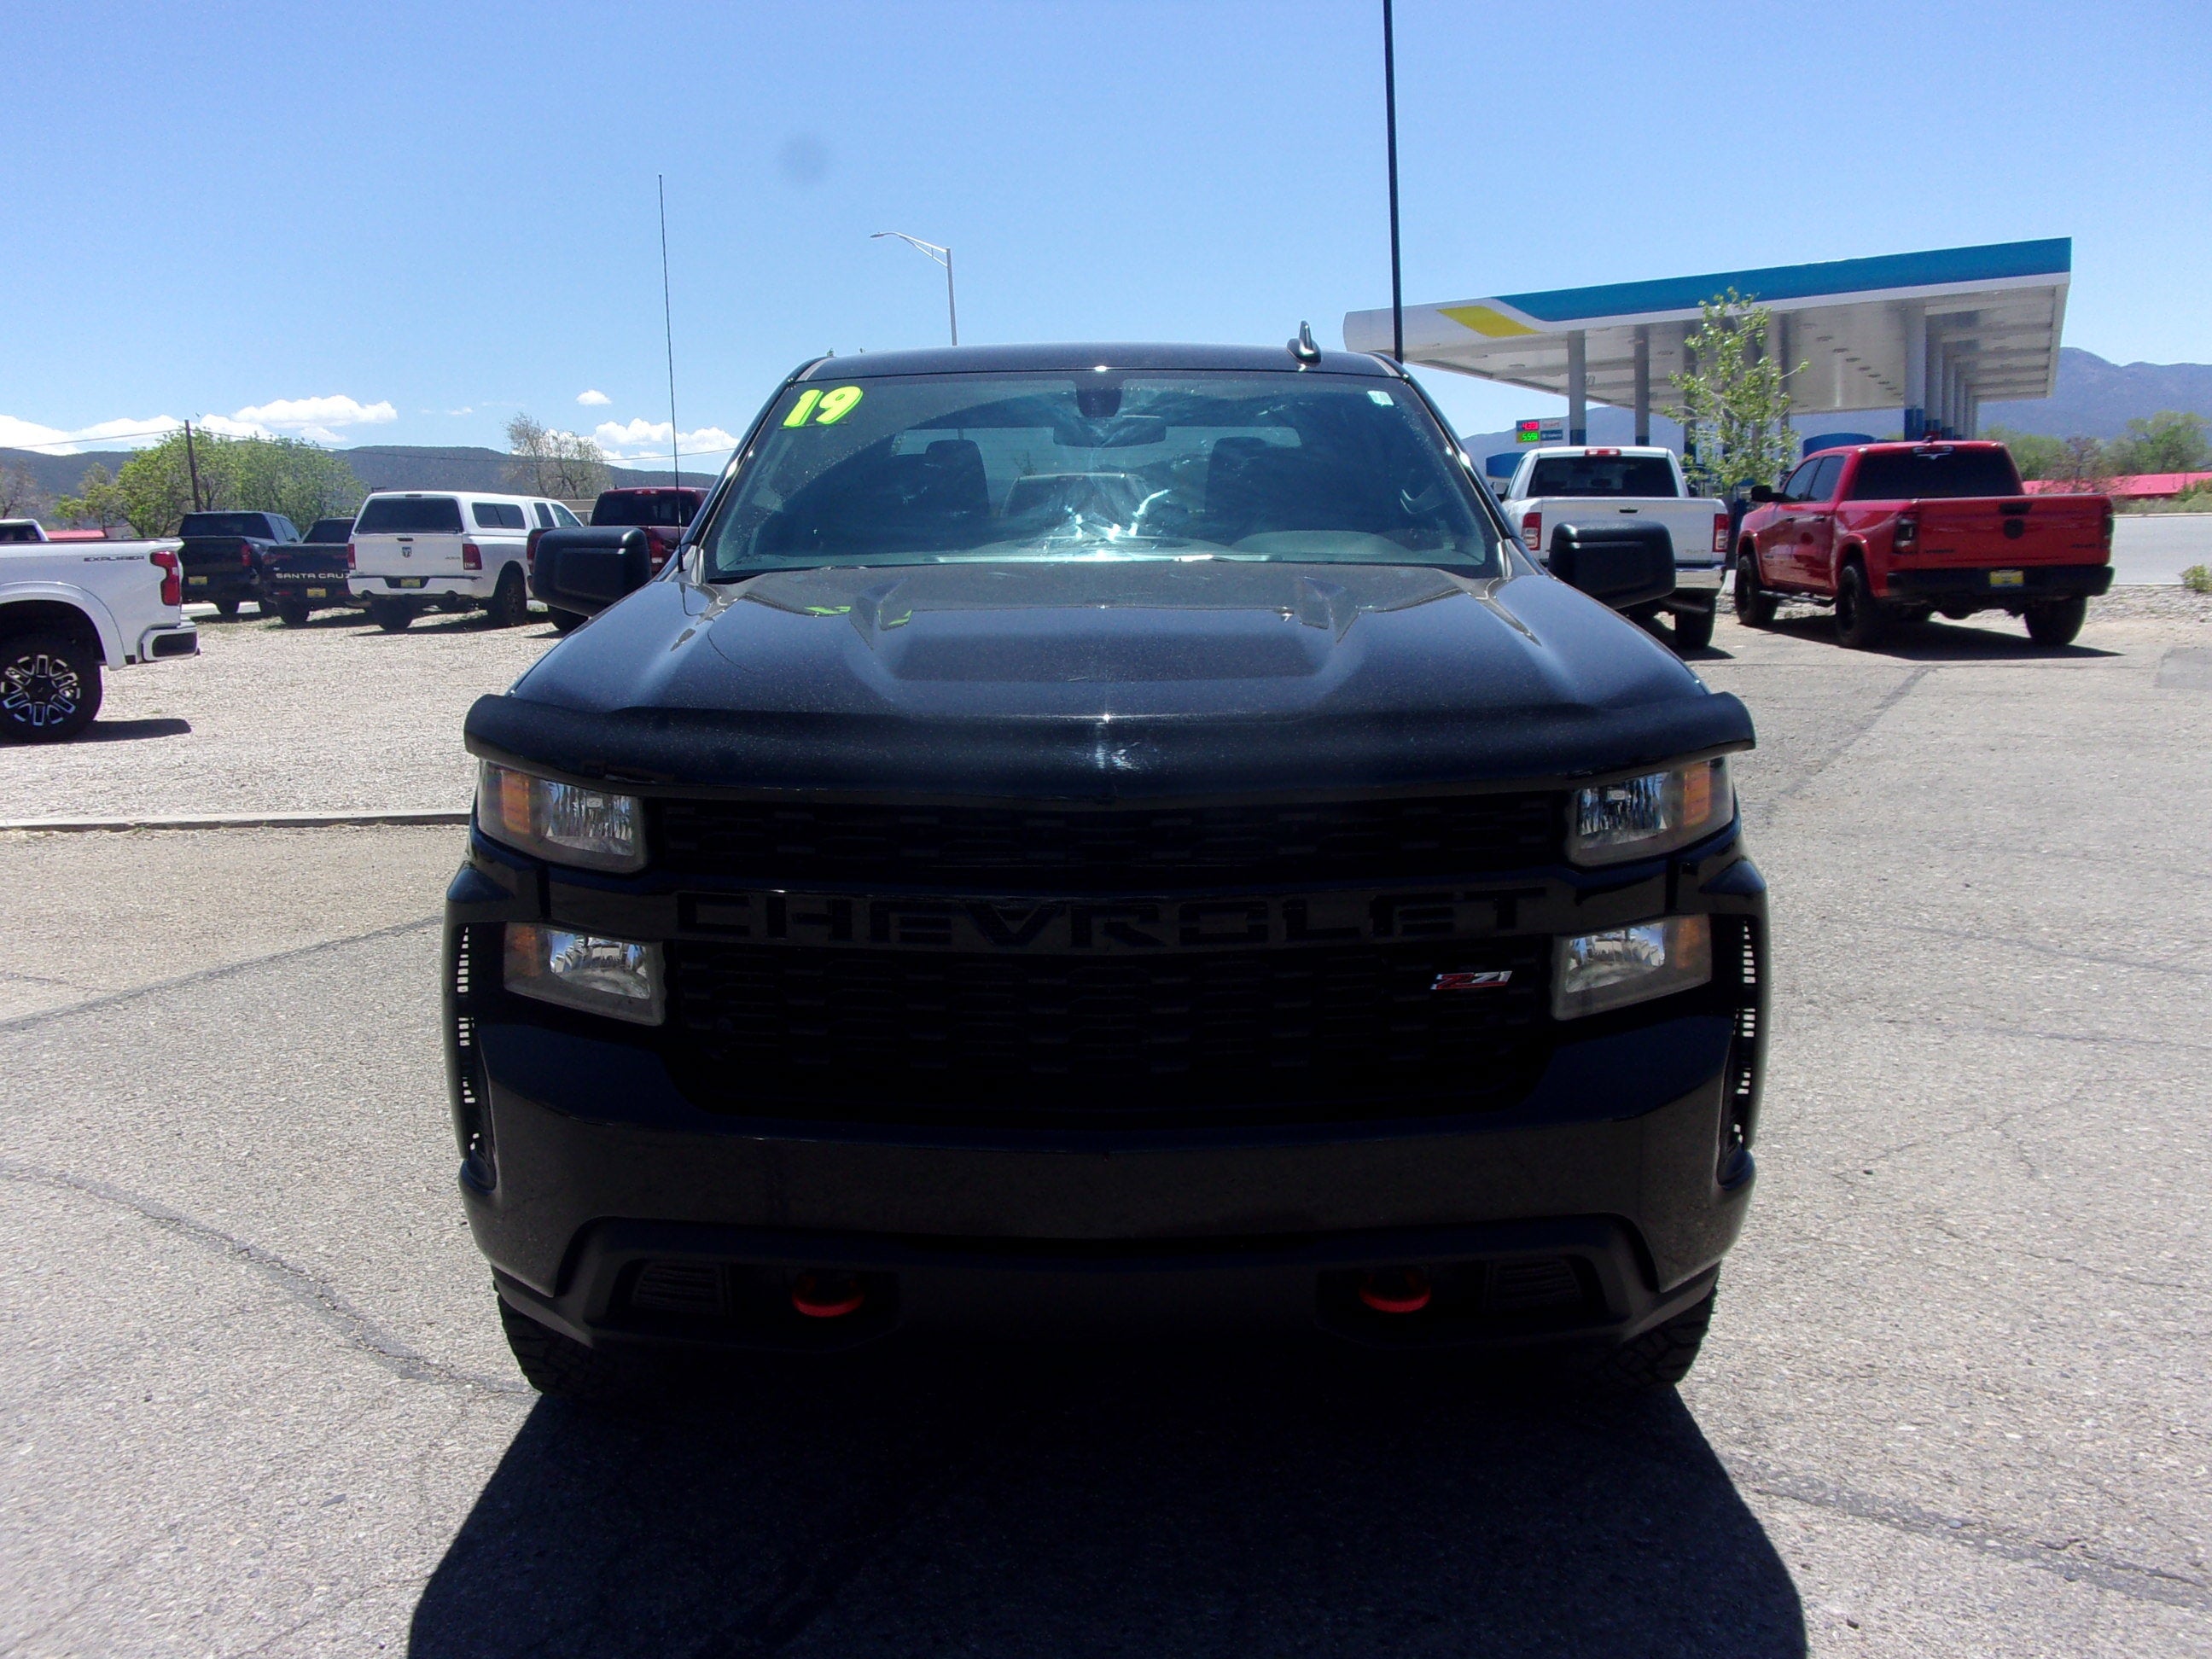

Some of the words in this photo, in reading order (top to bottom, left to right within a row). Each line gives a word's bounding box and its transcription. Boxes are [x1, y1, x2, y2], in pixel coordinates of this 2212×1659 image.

[783, 386, 864, 428] 19
[678, 887, 1546, 947] CHEVROLET
[1430, 970, 1513, 990] Z71
